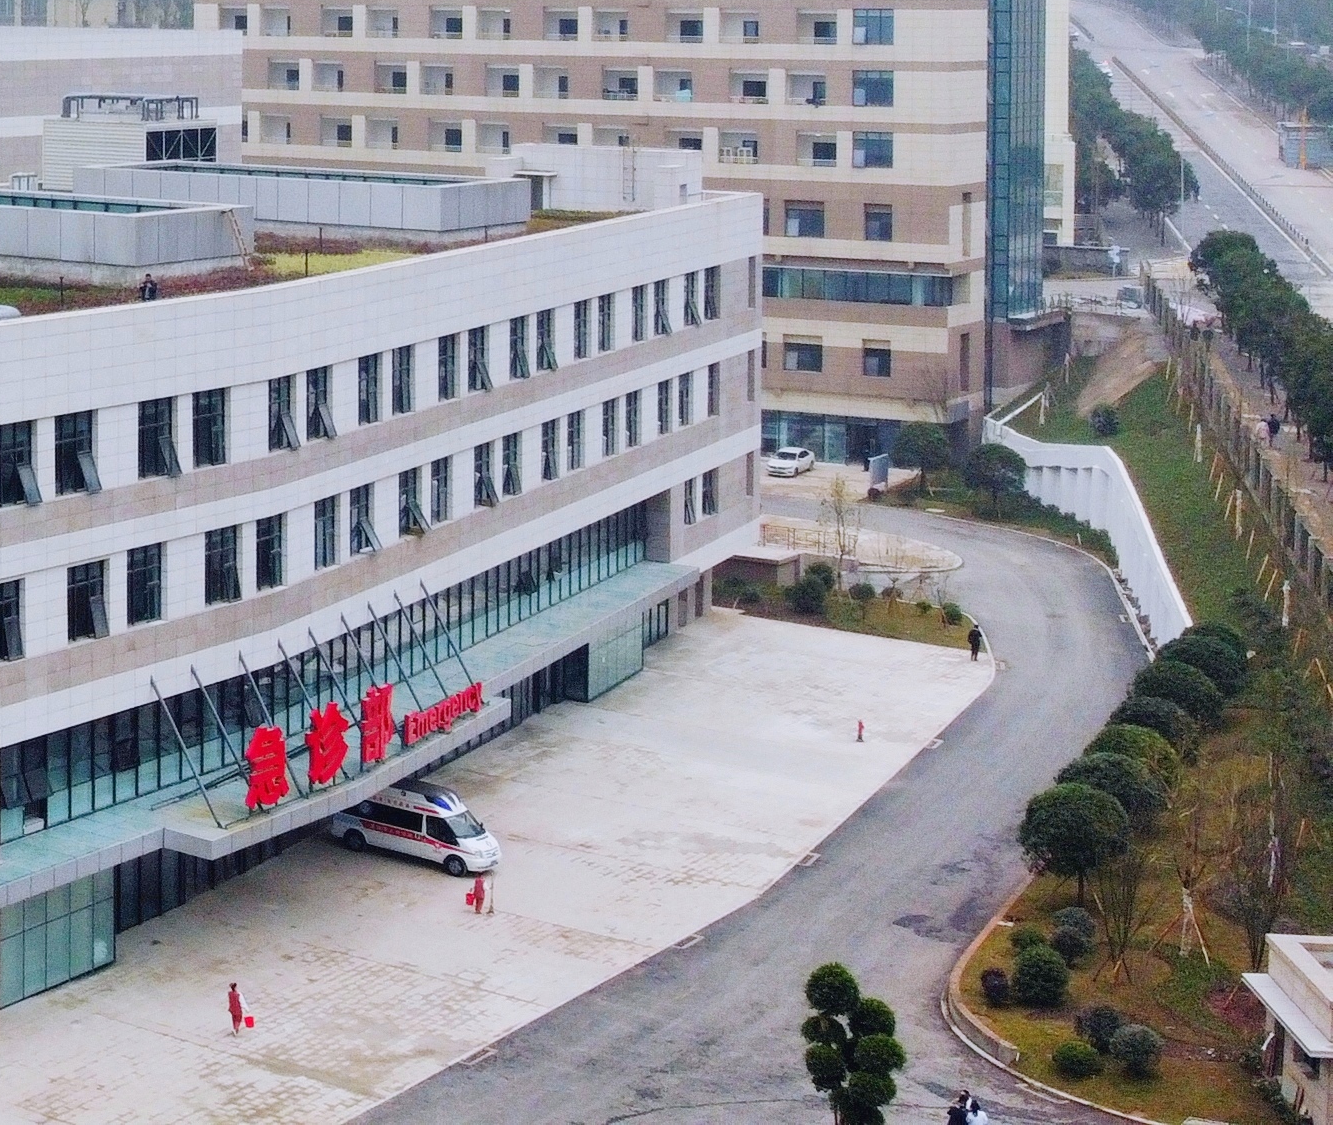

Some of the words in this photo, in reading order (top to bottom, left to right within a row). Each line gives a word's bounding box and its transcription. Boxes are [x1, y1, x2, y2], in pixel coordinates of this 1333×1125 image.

[245, 683, 395, 809] 急诊部
[404, 682, 483, 745] Emergency
